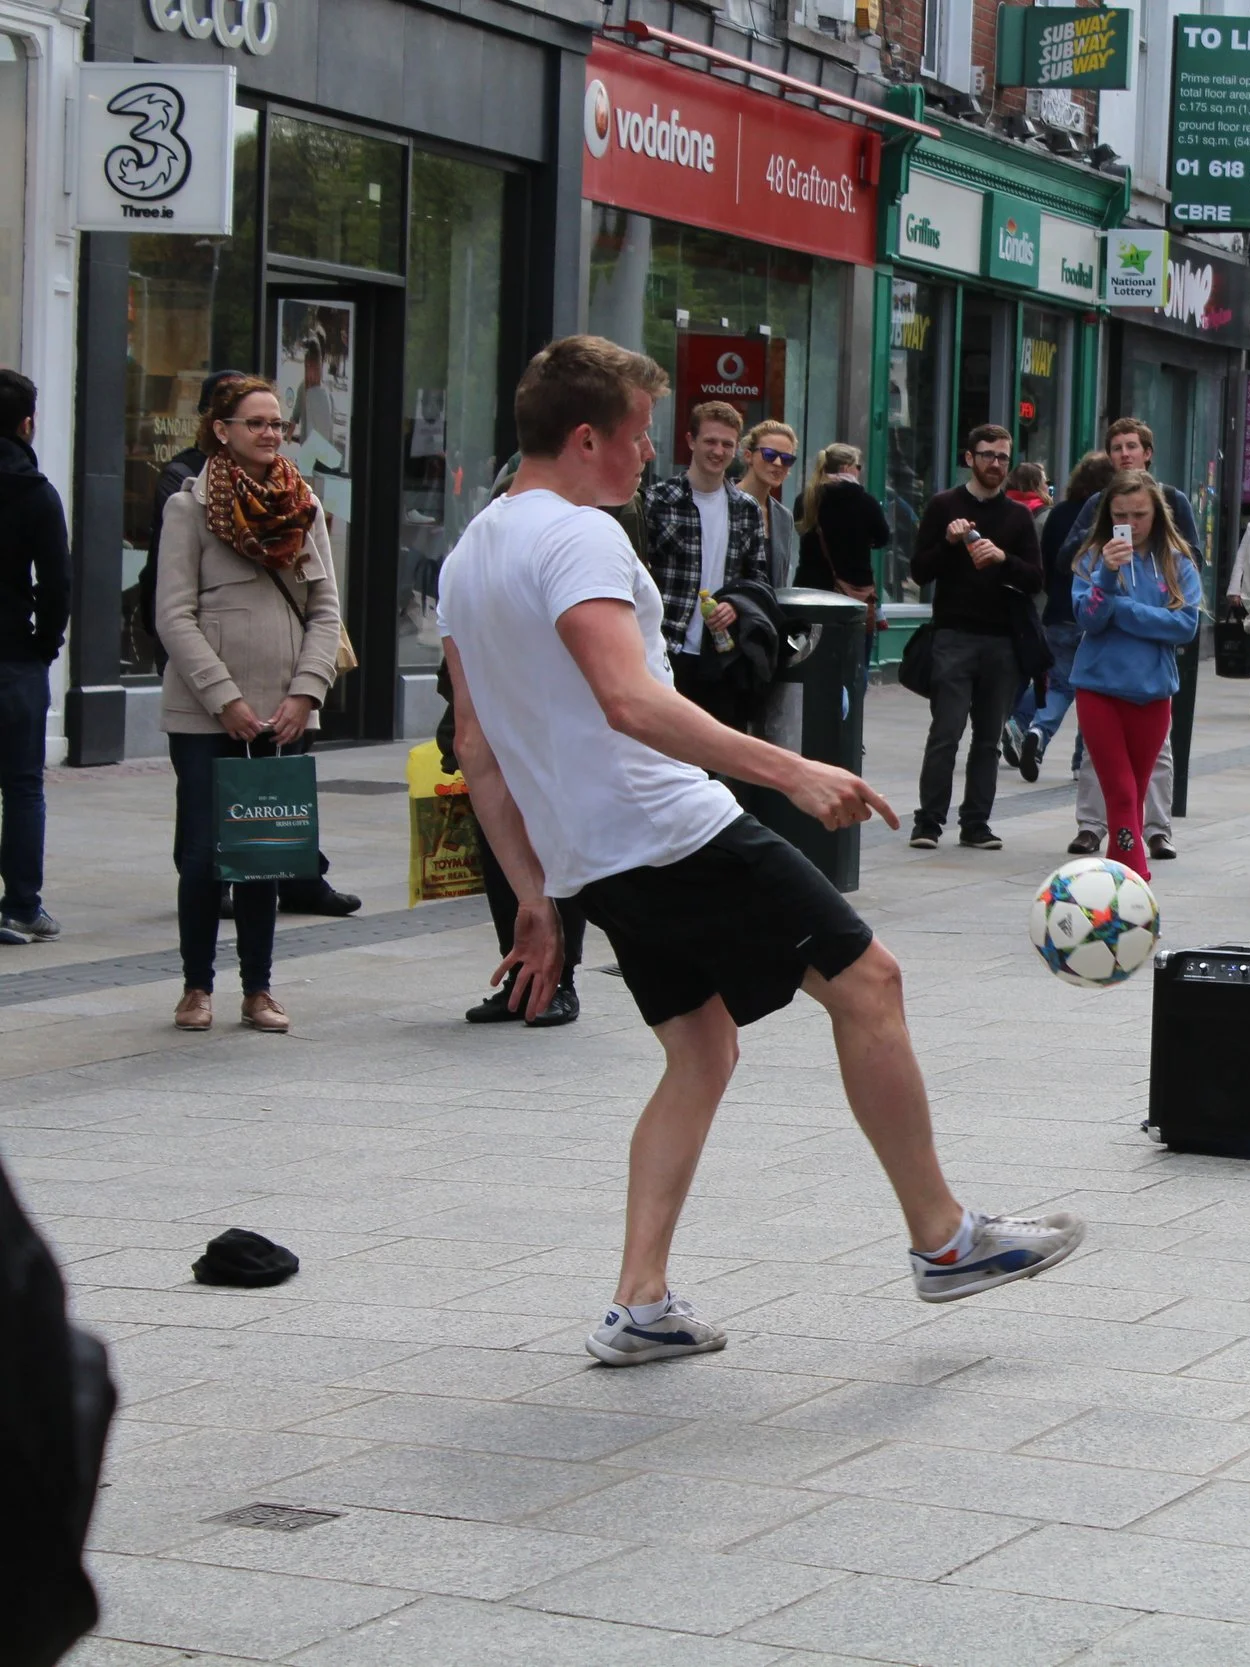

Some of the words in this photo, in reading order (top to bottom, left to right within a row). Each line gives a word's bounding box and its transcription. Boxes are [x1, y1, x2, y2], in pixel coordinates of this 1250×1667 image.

[1039, 10, 1117, 46] SUBWAY
[1184, 27, 1222, 49] TO
[1038, 29, 1116, 65] SUBWAY
[1038, 48, 1116, 84] SUBWAY
[1181, 73, 1209, 83] Prime
[1213, 74, 1237, 85] retail
[1180, 88, 1202, 97] total
[1205, 89, 1226, 99] floor
[1179, 103, 1208, 112] c.175
[1178, 121, 1215, 132] ground
[1217, 121, 1239, 132] floor
[615, 103, 716, 174] vodafone
[1178, 135, 1199, 144] c.51
[1202, 137, 1231, 147] sq.m.
[1176, 158, 1199, 176] 01
[1208, 160, 1245, 178] 618
[766, 154, 784, 194] 48
[787, 158, 838, 209] Grafton
[840, 174, 856, 213] St.
[121, 204, 174, 219] Three.ie
[1174, 204, 1232, 222] CBRE
[906, 213, 941, 250] Griffins
[999, 227, 1034, 266] Londis
[1061, 258, 1093, 290] Foodhall
[1111, 277, 1156, 287] National
[1114, 287, 1152, 297] Lottery
[701, 383, 759, 396] vodafone
[230, 804, 309, 820] CARROLLS
[244, 872, 296, 880] www.carrolls.ie
